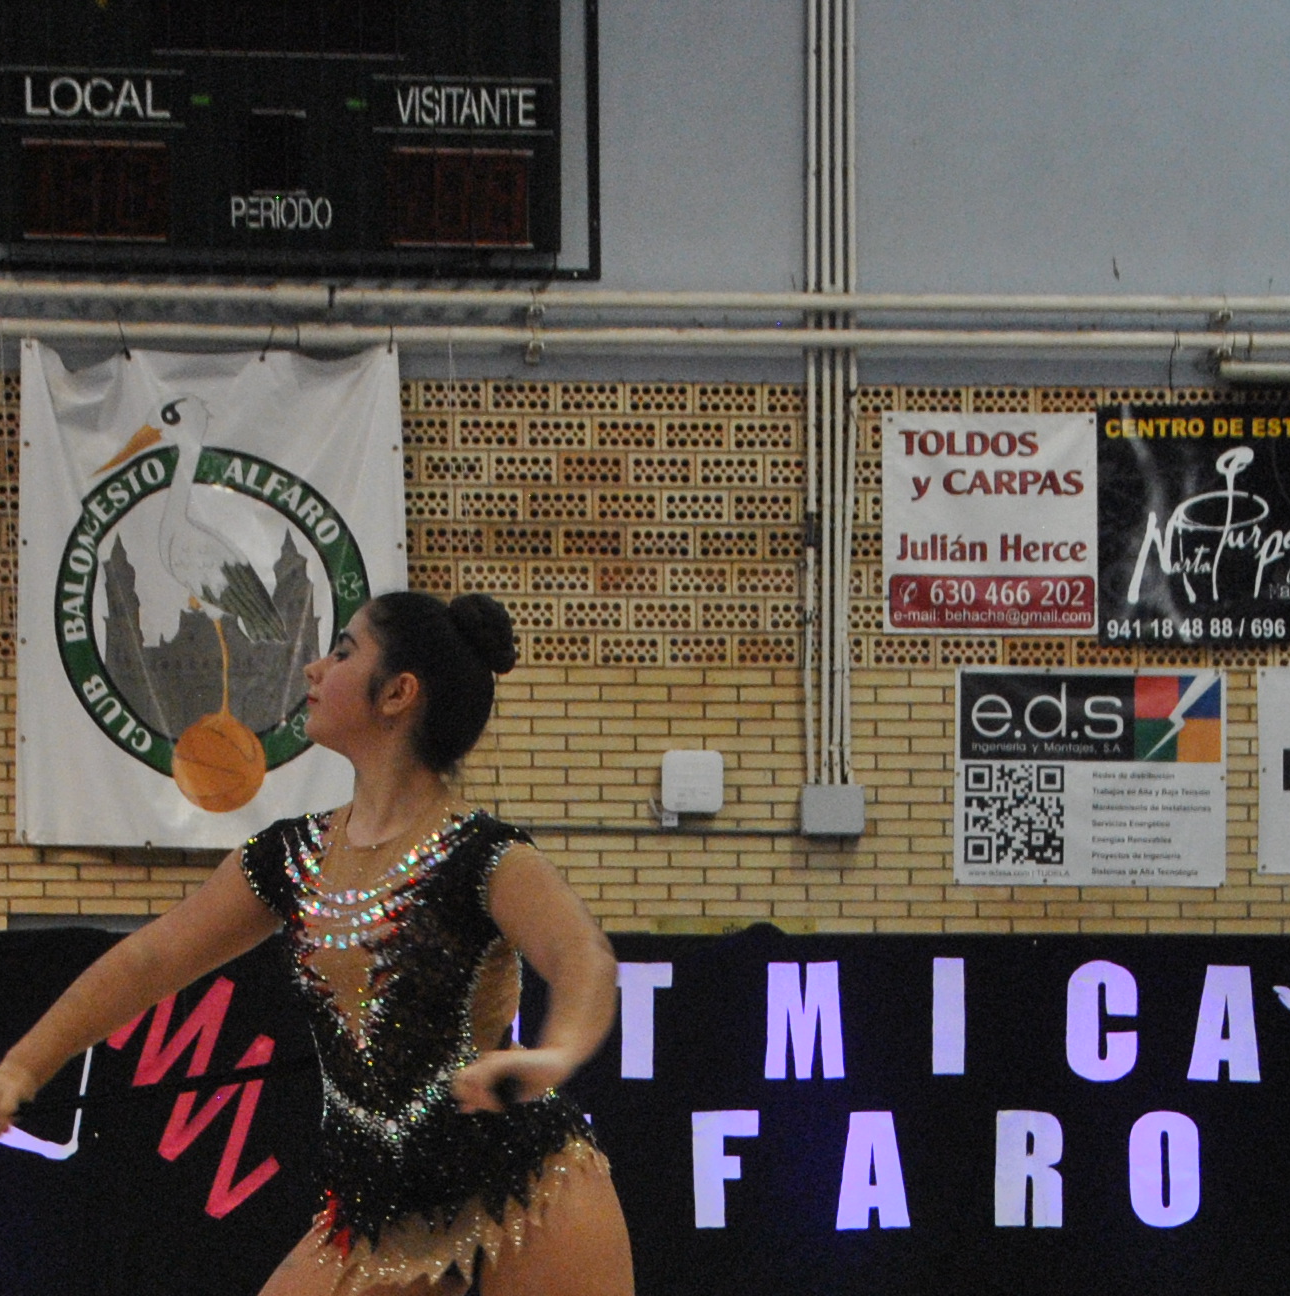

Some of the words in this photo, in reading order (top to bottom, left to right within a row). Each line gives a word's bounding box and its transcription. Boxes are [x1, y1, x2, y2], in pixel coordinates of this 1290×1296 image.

[24, 76, 171, 119] LOCAL
[395, 86, 537, 128] VISITANTE
[230, 196, 333, 230] PERIODO
[899, 429, 1039, 457] TOLDOS
[1105, 417, 1205, 439] CENTRO
[1212, 417, 1244, 438] DE
[223, 456, 341, 545] ALFARO
[912, 474, 932, 501] y
[942, 470, 1084, 496] CARPAS
[63, 456, 166, 643] BALONCESTO
[896, 532, 988, 563] Julián
[1000, 534, 1087, 563] Herce
[930, 579, 976, 606] 630
[984, 580, 1031, 606] 466
[1040, 580, 1085, 606] 202
[1106, 618, 1142, 640] 941
[1151, 618, 1174, 639] 18
[1180, 617, 1204, 639] 48
[1210, 617, 1234, 639] 88
[1250, 617, 1286, 639] 696
[81, 673, 153, 754] CLUB
[512, 956, 1262, 1082] TMICA
[583, 1109, 1202, 1230] FARO
